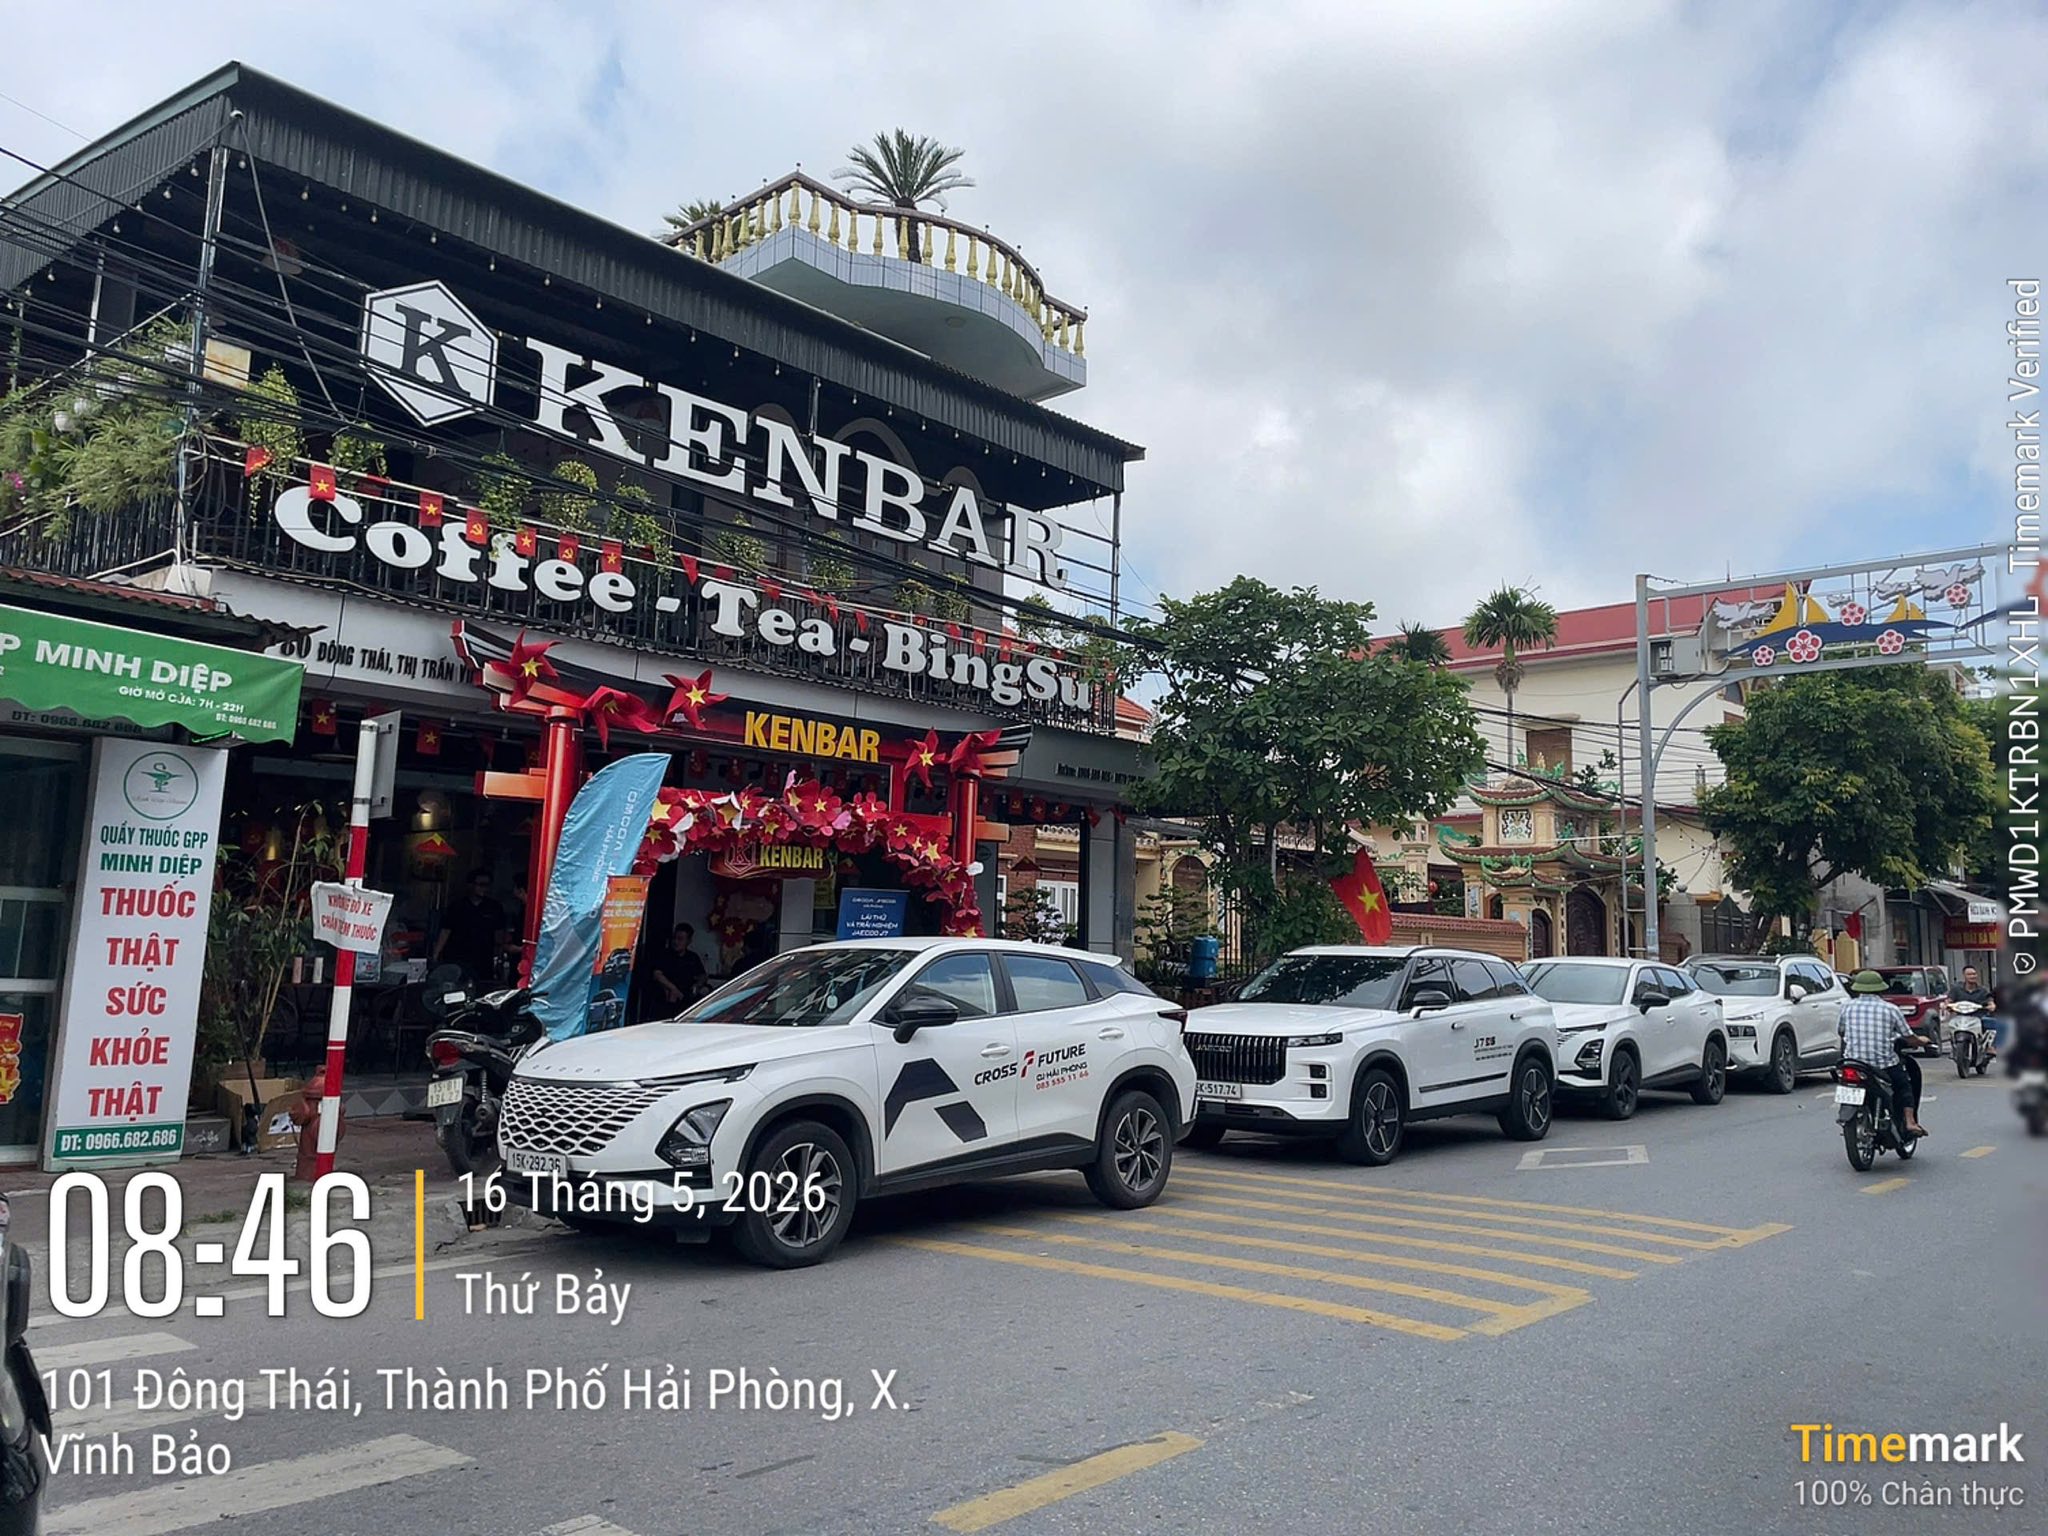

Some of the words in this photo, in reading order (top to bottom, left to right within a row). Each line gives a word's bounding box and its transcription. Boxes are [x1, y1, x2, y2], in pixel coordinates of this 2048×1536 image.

[523, 337, 1068, 589] KENBAR
[275, 486, 636, 612] Coffee
[701, 582, 836, 656] Tea
[882, 623, 1093, 710] BingSu
[35, 640, 141, 678] MINH
[151, 660, 233, 694] DIỆP
[317, 640, 354, 665] ĐÔNG
[360, 647, 393, 674] THÁI,
[397, 655, 418, 679] THỊ
[199, 698, 214, 709] 7H
[222, 703, 244, 714] 22H
[744, 711, 880, 763] KENBAR
[139, 824, 180, 847] THUỐC
[183, 831, 209, 849] GPP
[100, 853, 153, 873] MINH
[159, 853, 202, 879] DIỆP
[760, 845, 823, 869] KENBAR
[100, 880, 196, 918] THUỐC
[107, 931, 179, 972] THẬT
[106, 981, 166, 1017] SỨC
[90, 1027, 170, 1066] KHỎE
[1038, 1043, 1086, 1067] FUTURE
[974, 1062, 1018, 1085] CROSS
[88, 1081, 162, 1121] THẬT
[61, 1135, 82, 1151] ĐT:
[86, 1129, 176, 1150] 0966.682.686
